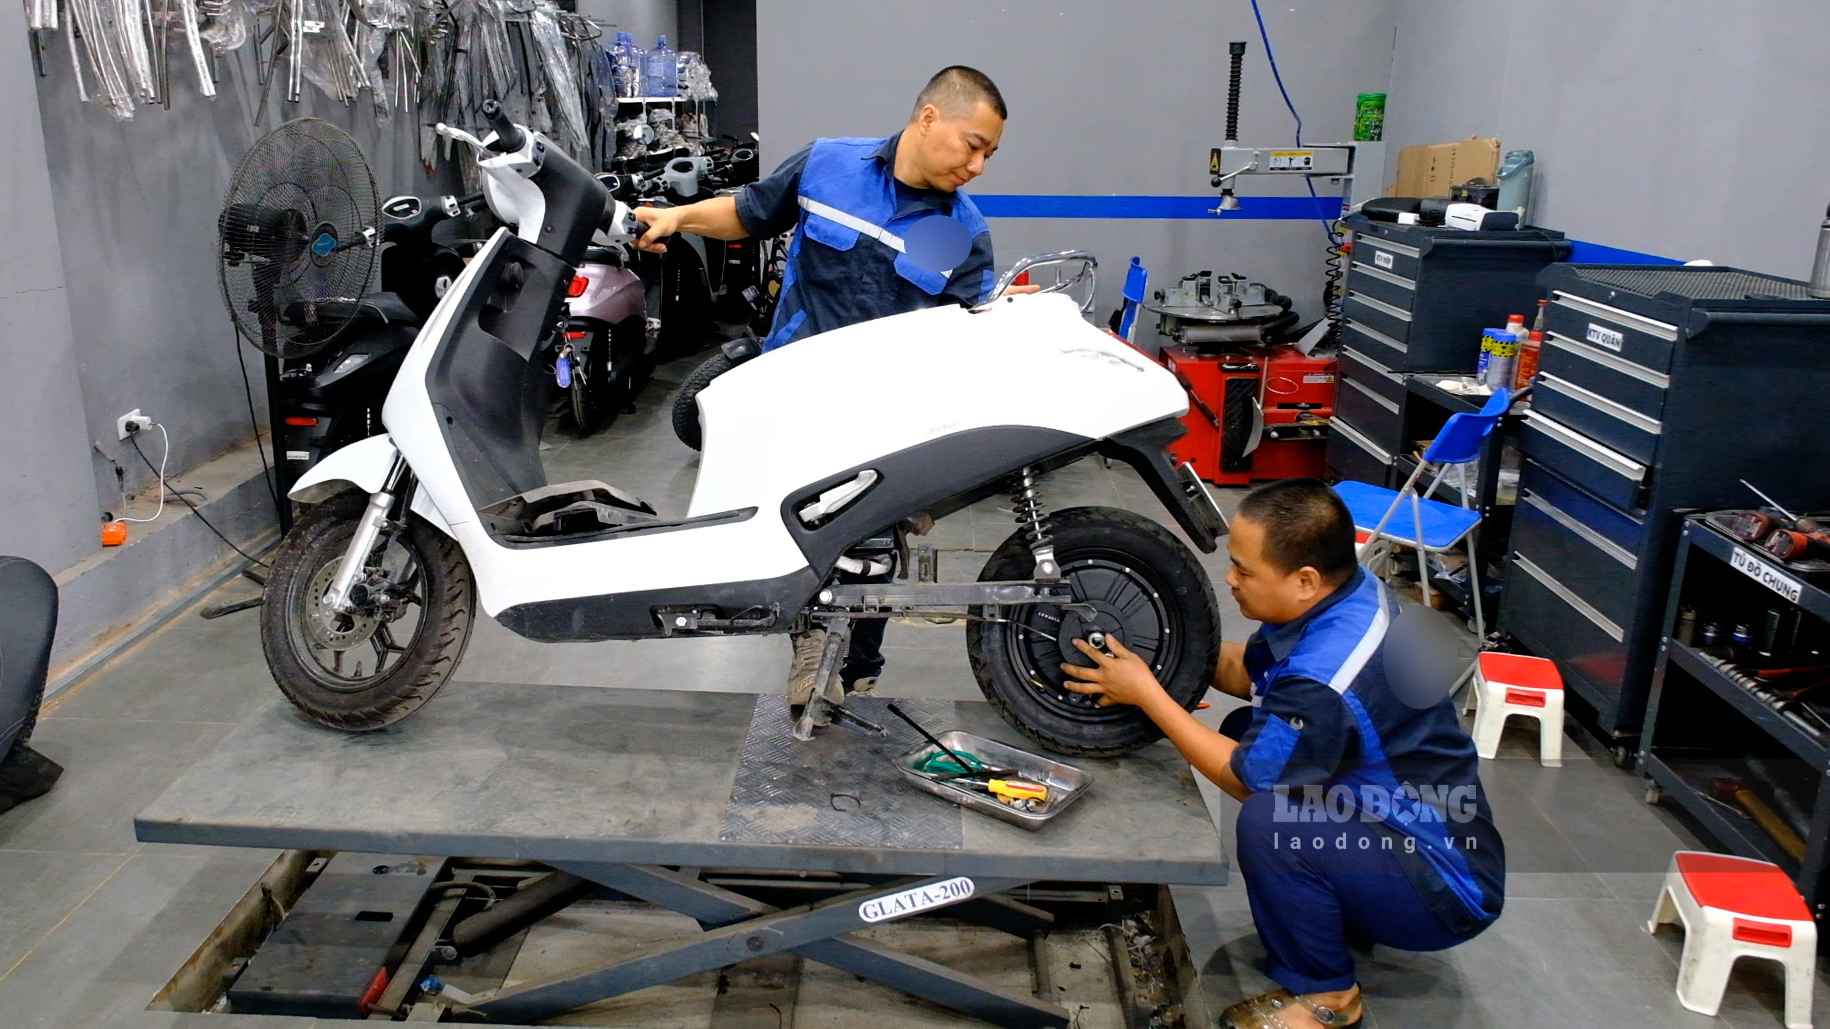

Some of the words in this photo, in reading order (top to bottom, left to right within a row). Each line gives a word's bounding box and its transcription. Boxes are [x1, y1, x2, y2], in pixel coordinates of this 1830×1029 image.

[1588, 328, 1602, 341] KTV
[1763, 572, 1799, 602] CHUNG
[862, 878, 971, 920] GLATA-200
